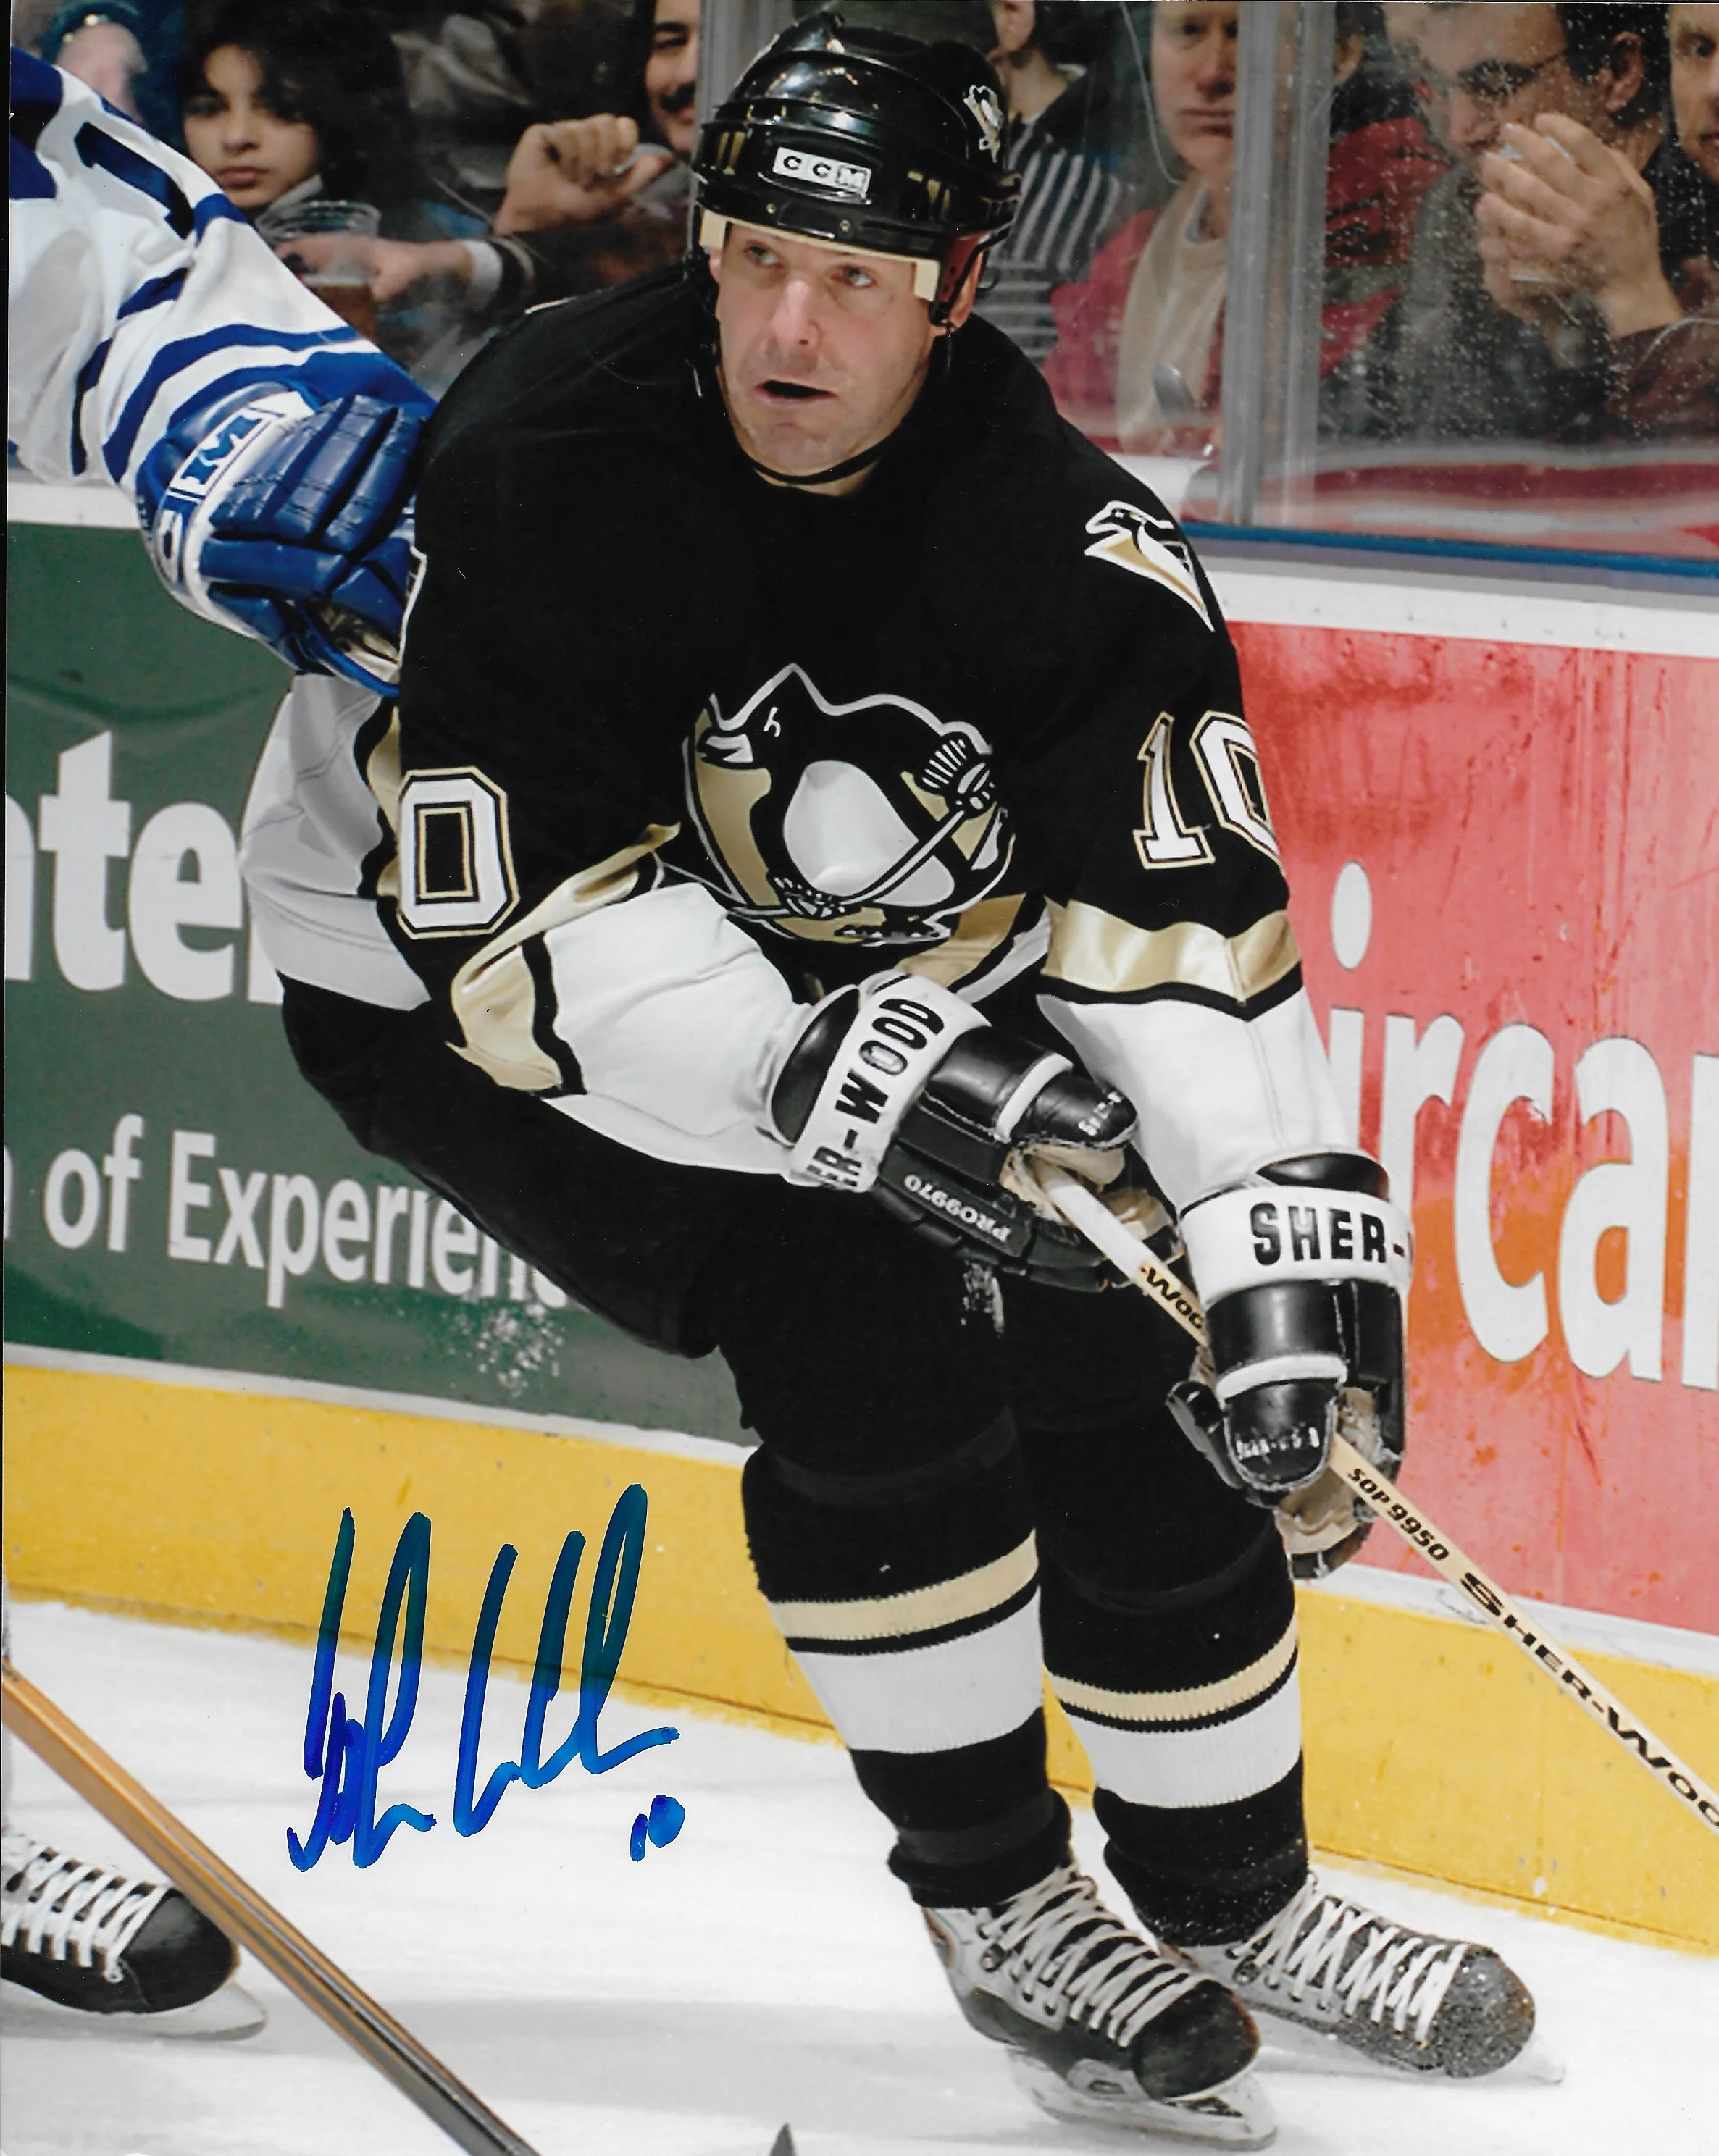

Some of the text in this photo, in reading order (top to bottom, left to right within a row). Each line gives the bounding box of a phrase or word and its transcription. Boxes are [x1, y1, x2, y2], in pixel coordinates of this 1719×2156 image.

[783, 155, 868, 190] CCM
[1132, 710, 1284, 875] 10
[397, 765, 520, 939] 0
[45, 1114, 142, 1251] of
[1329, 861, 1719, 1391] irca
[904, 1174, 1011, 1241] PRO9970
[1250, 1202, 1413, 1265] SHER-
[1348, 1468, 1390, 1503] SOP
[1387, 1503, 1450, 1561] 9950
